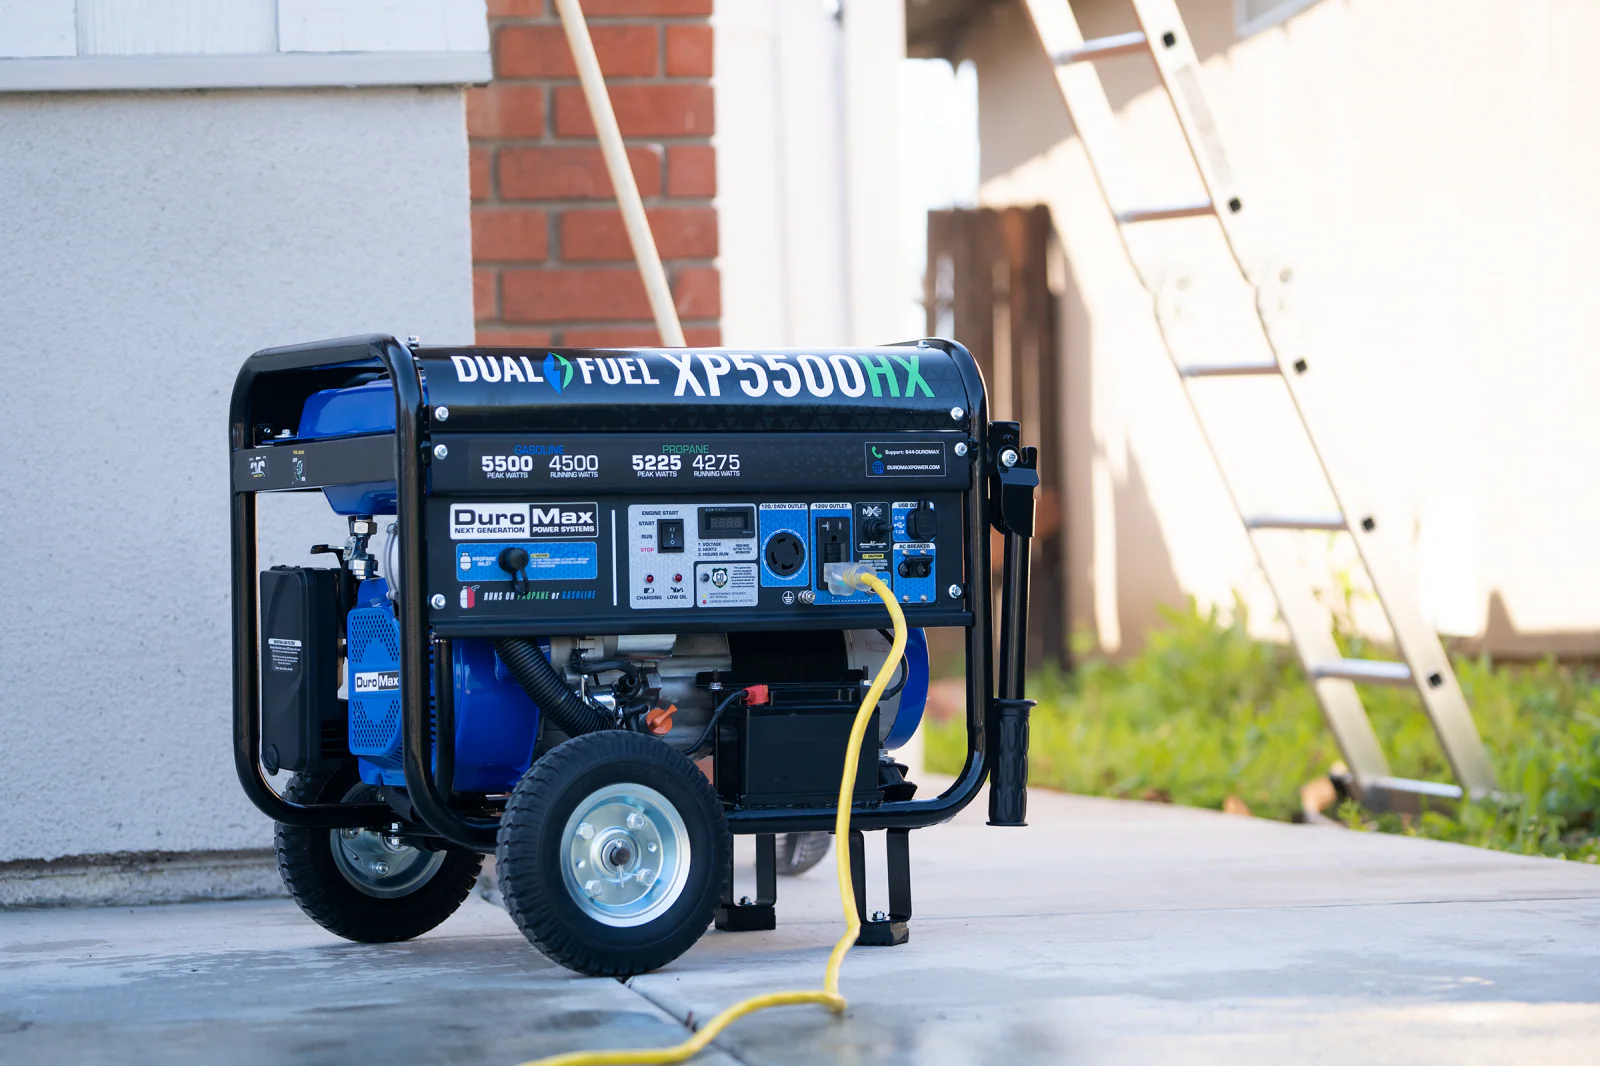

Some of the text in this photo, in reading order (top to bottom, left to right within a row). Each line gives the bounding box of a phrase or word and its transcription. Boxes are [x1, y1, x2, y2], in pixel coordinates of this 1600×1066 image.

[450, 354, 935, 398] DUAL FUEL XP5500HX
[514, 445, 564, 455] GASOLINE
[662, 444, 709, 454] PROPANE
[481, 456, 533, 472] 5500
[549, 454, 598, 471] 4500
[632, 454, 682, 470] 5225
[692, 454, 740, 470] 4275
[484, 592, 503, 601] RUNS
[506, 592, 515, 600] ON
[561, 590, 596, 599] GASOLINE
